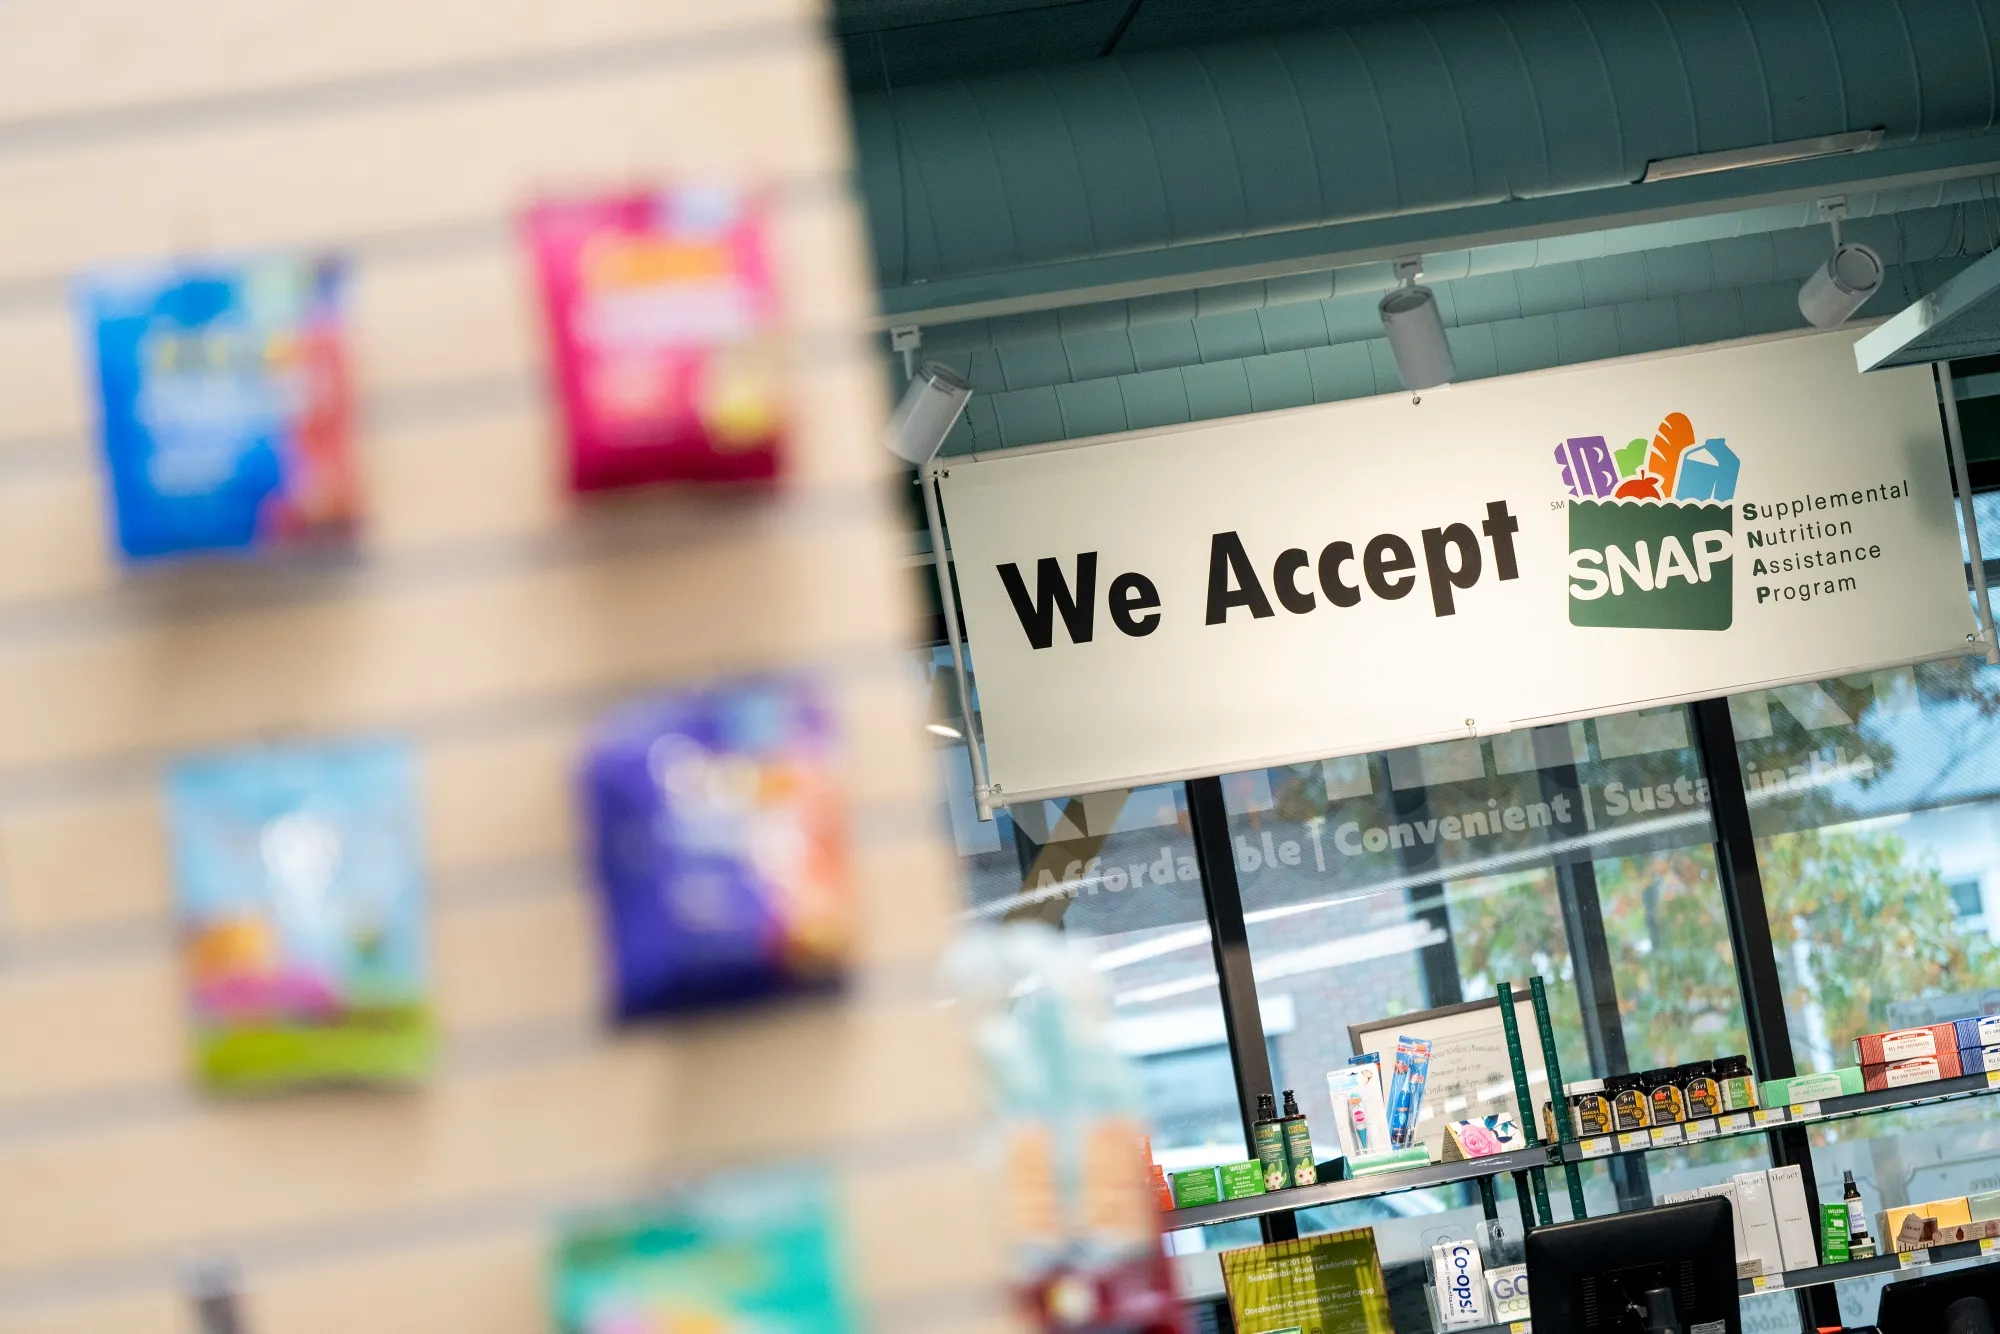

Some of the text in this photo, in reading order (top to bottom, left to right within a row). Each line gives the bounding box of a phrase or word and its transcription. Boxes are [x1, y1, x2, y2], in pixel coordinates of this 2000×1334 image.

[1550, 500, 1565, 511] SM
[1742, 480, 1909, 521] Supplemental
[1747, 519, 1854, 549] Nutrition
[1568, 529, 1734, 601] SNAP
[1752, 543, 1882, 577] Assistance
[996, 500, 1519, 650] We Accept
[1756, 574, 1857, 605] Program
[1334, 792, 1571, 857] Convenient
[1623, 1094, 1634, 1103] pri
[1695, 1082, 1706, 1091] pri
[1587, 1101, 1598, 1109] pri
[1229, 1163, 1252, 1172] WELEDA
[1786, 1171, 1800, 1179] act
[1248, 1258, 1358, 1283] Sustainable Food Leadership
[1305, 1254, 1328, 1264] Green
[1293, 1273, 1316, 1284] Award
[1452, 1246, 1478, 1314] Co-ops!
[1244, 1303, 1287, 1316] Dorchester
[1287, 1296, 1331, 1308] Community
[1332, 1291, 1351, 1300] Food
[1352, 1287, 1375, 1297] Co-op
